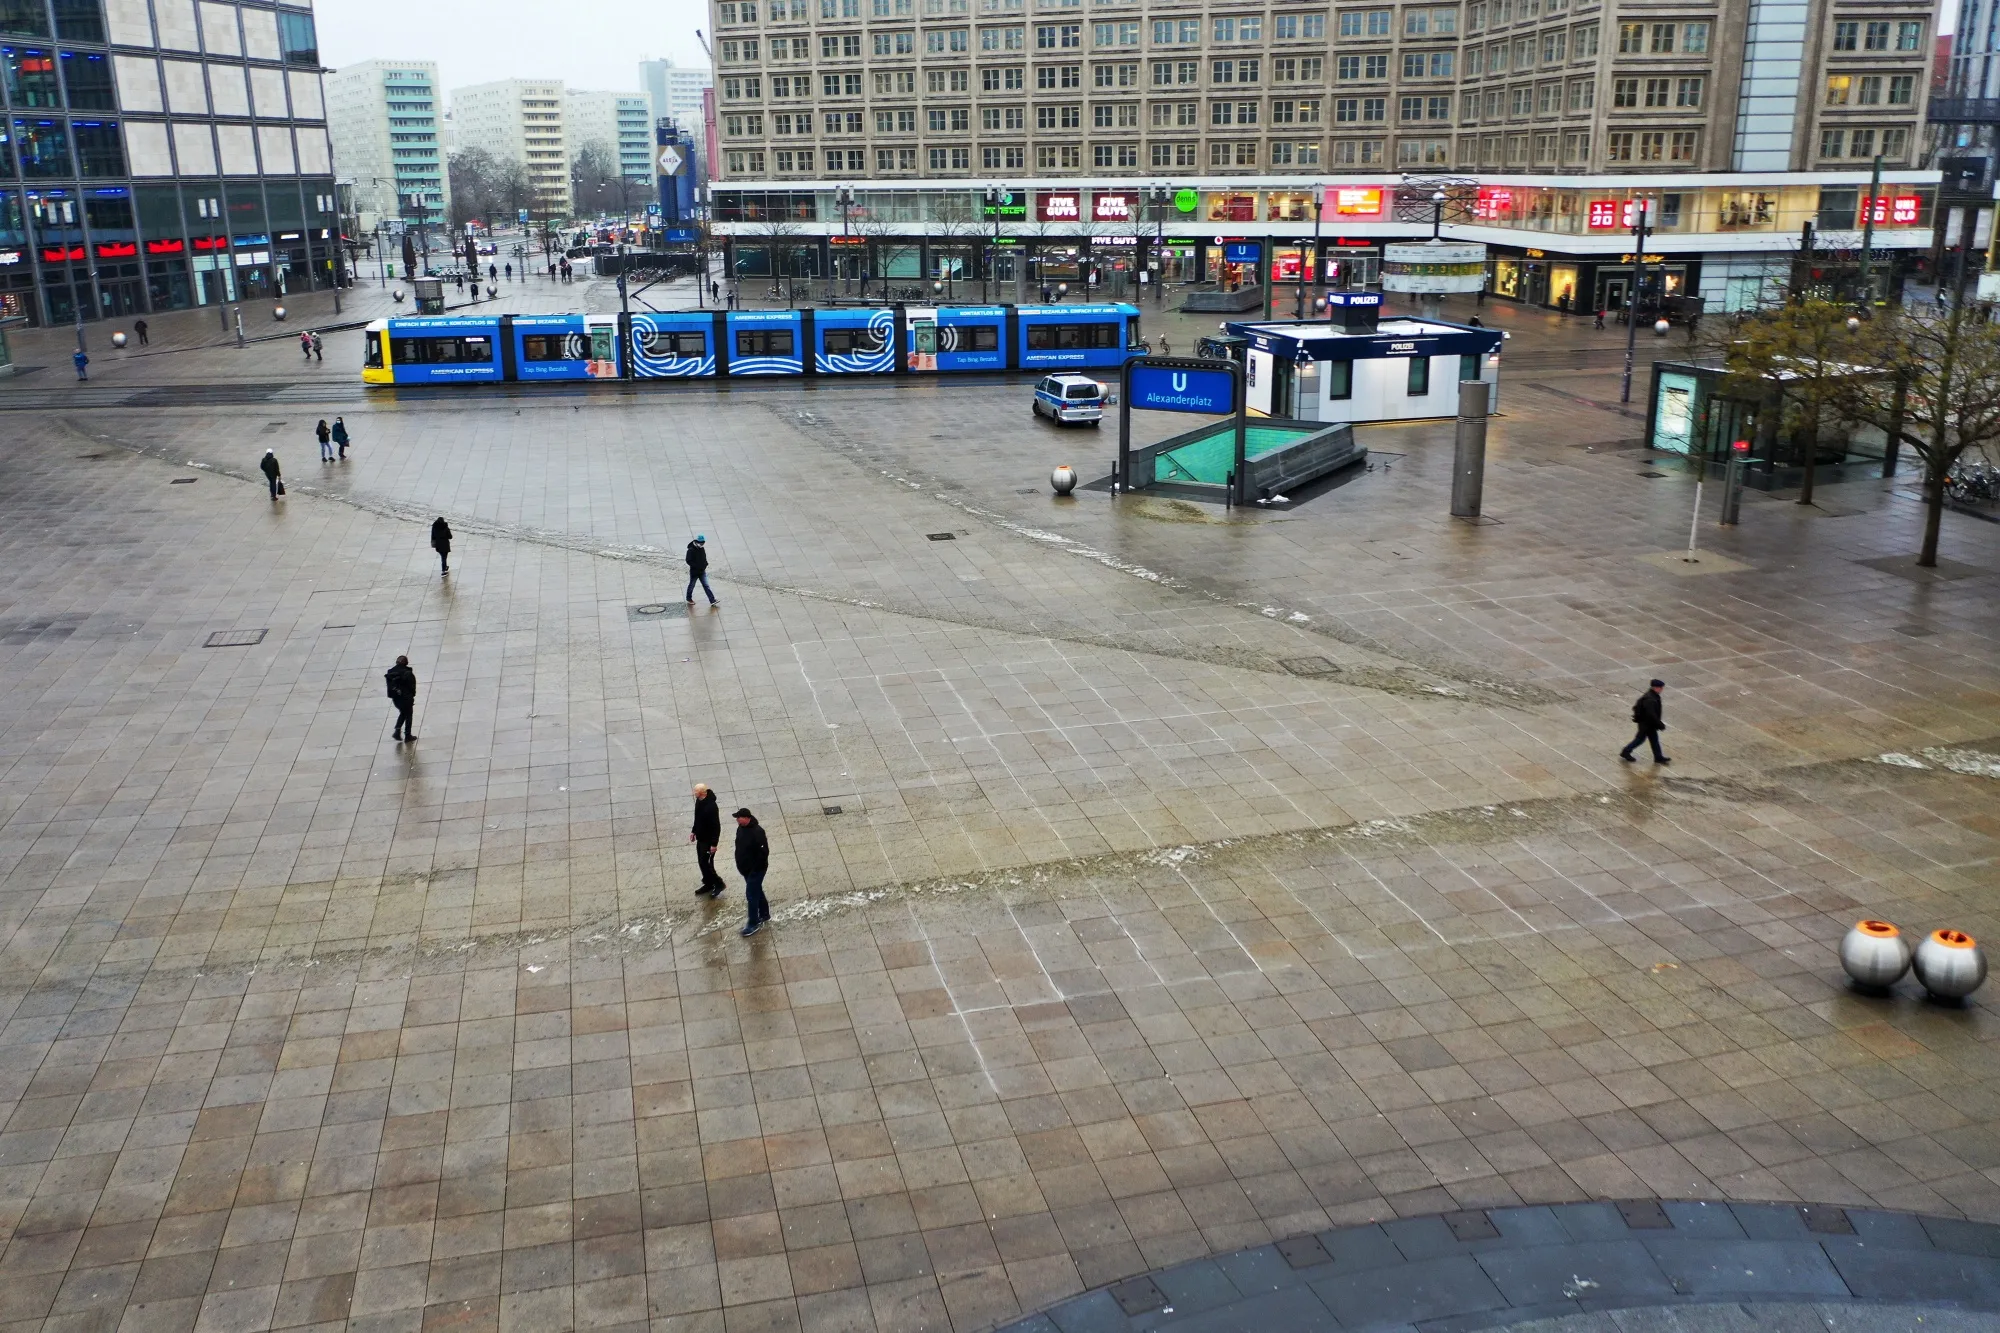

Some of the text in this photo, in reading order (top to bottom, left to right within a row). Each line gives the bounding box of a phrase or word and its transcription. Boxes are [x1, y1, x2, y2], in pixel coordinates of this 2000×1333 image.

[1049, 197, 1075, 206] FIVE
[1099, 197, 1125, 206] FIVE
[1895, 200, 1916, 210] UNI
[1047, 206, 1077, 216] GUYS
[1096, 206, 1128, 216] GUYS
[1592, 204, 1614, 215] ユニ
[679, 229, 686, 237] U
[1091, 237, 1137, 245] FIVE GUYS
[1238, 245, 1246, 255] U
[1427, 265, 1434, 273] 2
[1440, 265, 1447, 273] 3
[1350, 296, 1379, 305] POLIZEI
[465, 367, 494, 375] EXPRESS
[1172, 372, 1187, 392] U
[1146, 392, 1212, 408] Alexanderplatz
